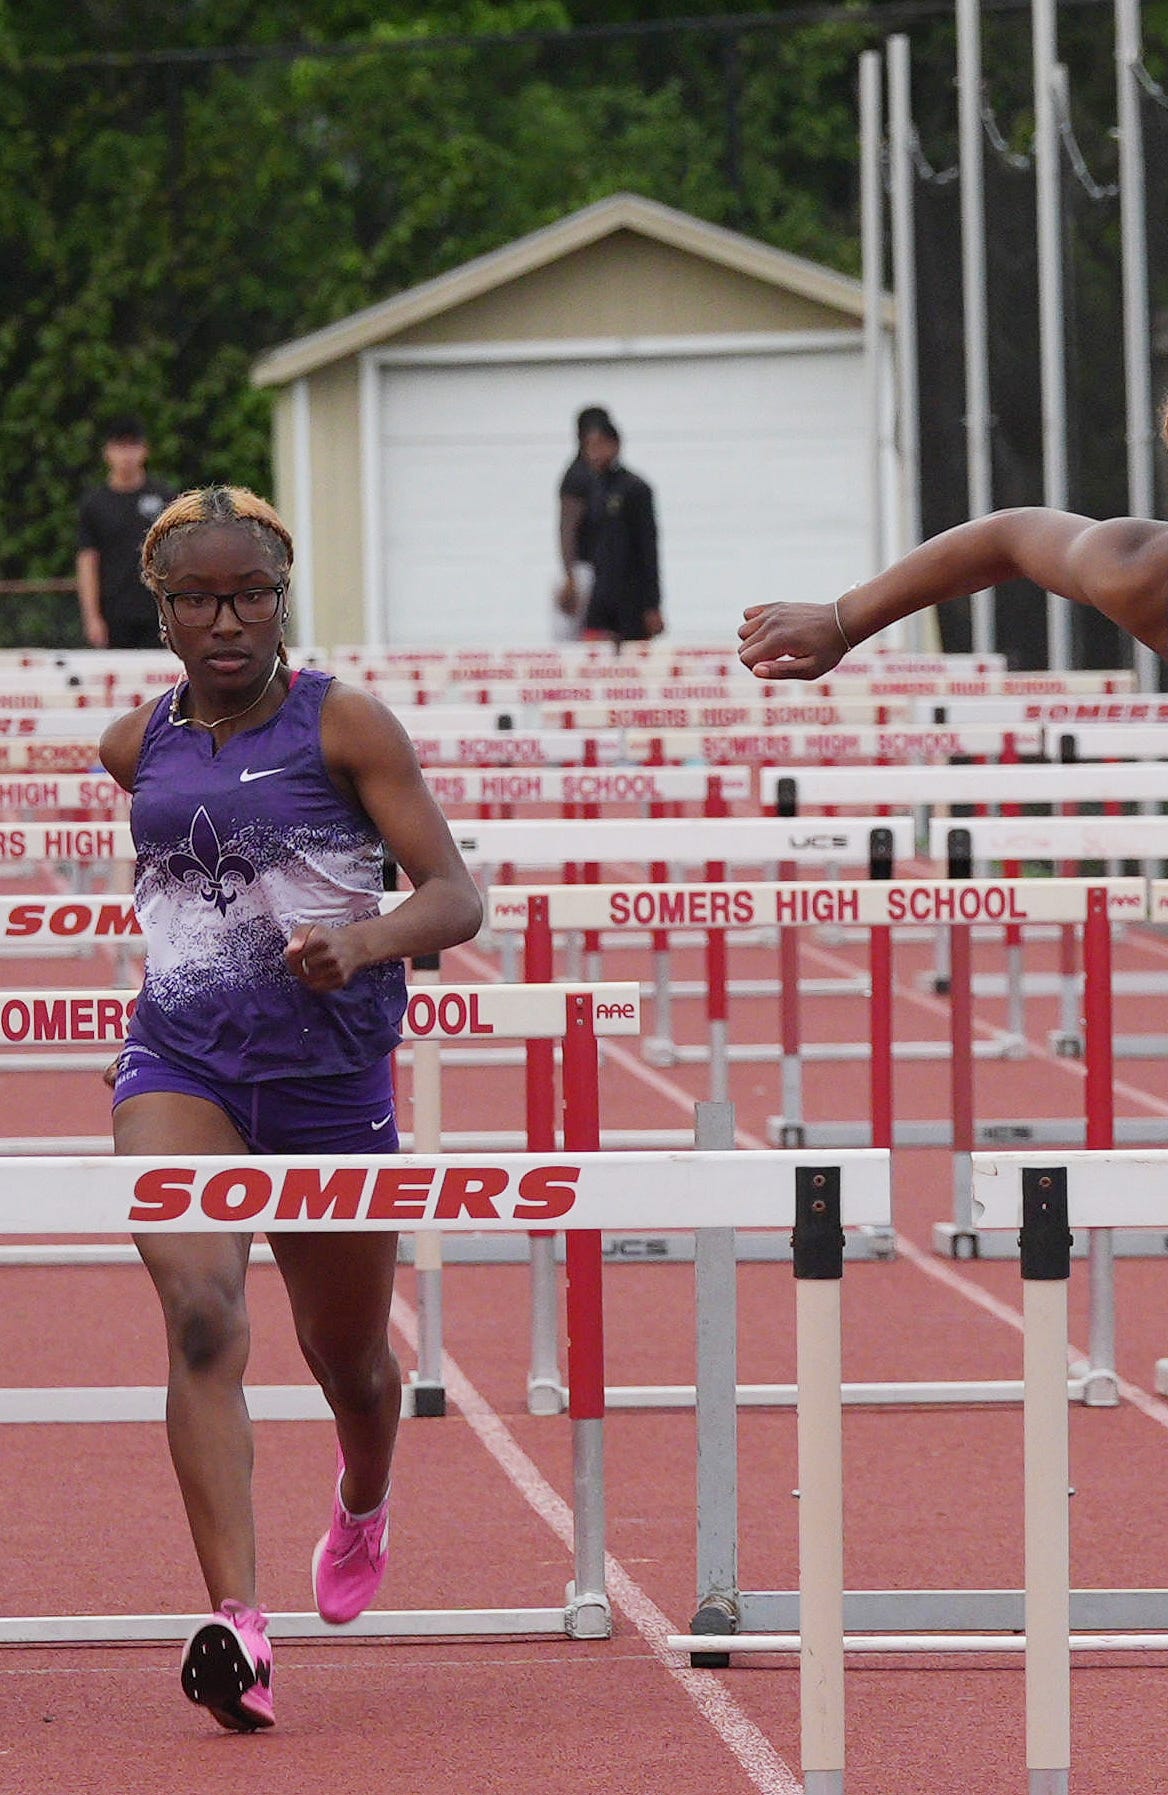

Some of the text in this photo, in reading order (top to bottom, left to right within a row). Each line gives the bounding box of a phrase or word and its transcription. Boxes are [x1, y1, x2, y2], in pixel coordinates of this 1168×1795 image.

[563, 775, 662, 800] SCHOOL
[45, 831, 115, 857] HIGH
[789, 835, 848, 849] UCS
[610, 886, 1028, 924] SOMERS HIGH SCHOOL
[128, 1167, 581, 1222] SOMERS
